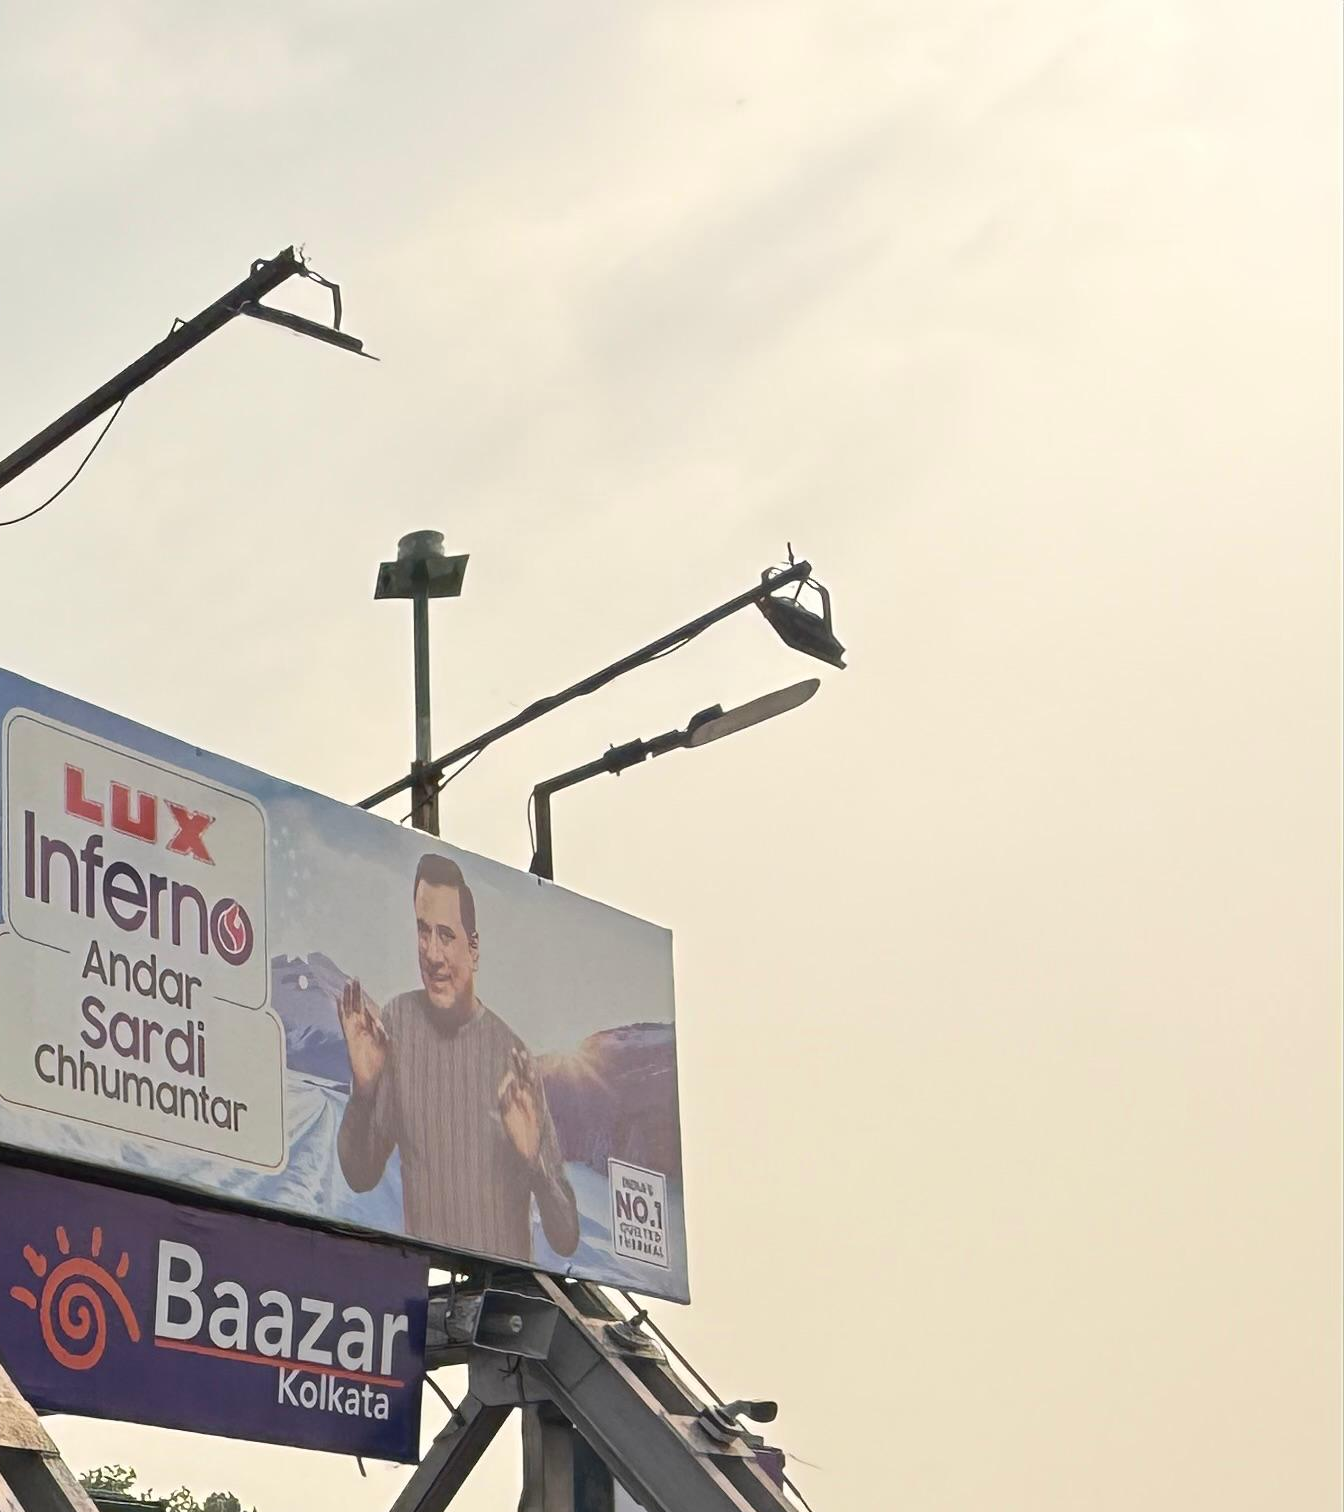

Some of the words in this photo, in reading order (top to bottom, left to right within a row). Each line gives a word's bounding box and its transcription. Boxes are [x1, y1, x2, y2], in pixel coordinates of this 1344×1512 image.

[64, 762, 217, 865] LUX
[24, 810, 254, 966] Inferno
[81, 940, 202, 1010] Andar
[80, 995, 206, 1078] Sardi
[34, 1043, 248, 1132] Chhumantar
[615, 1190, 663, 1230] NO.1
[154, 1239, 409, 1377] Baazar
[277, 1367, 391, 1421] Kolkata
